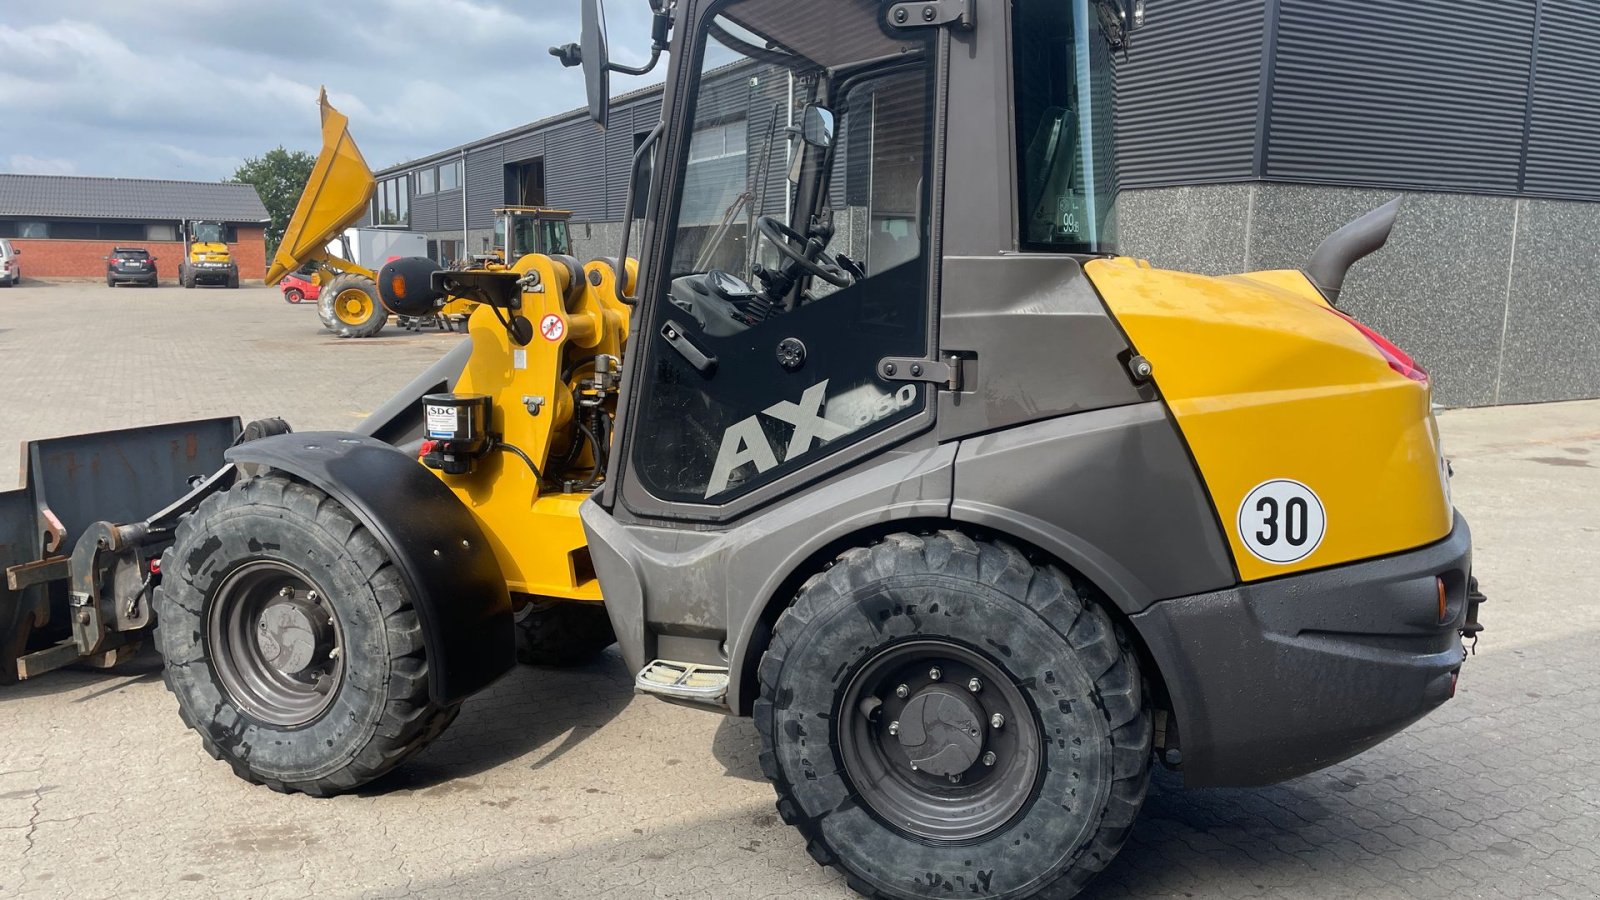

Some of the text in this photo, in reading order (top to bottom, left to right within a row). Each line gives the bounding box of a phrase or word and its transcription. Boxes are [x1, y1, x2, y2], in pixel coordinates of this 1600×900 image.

[1063, 213, 1074, 232] 99
[430, 406, 455, 415] SDC
[704, 378, 849, 499] AX
[1256, 496, 1308, 547] 30
